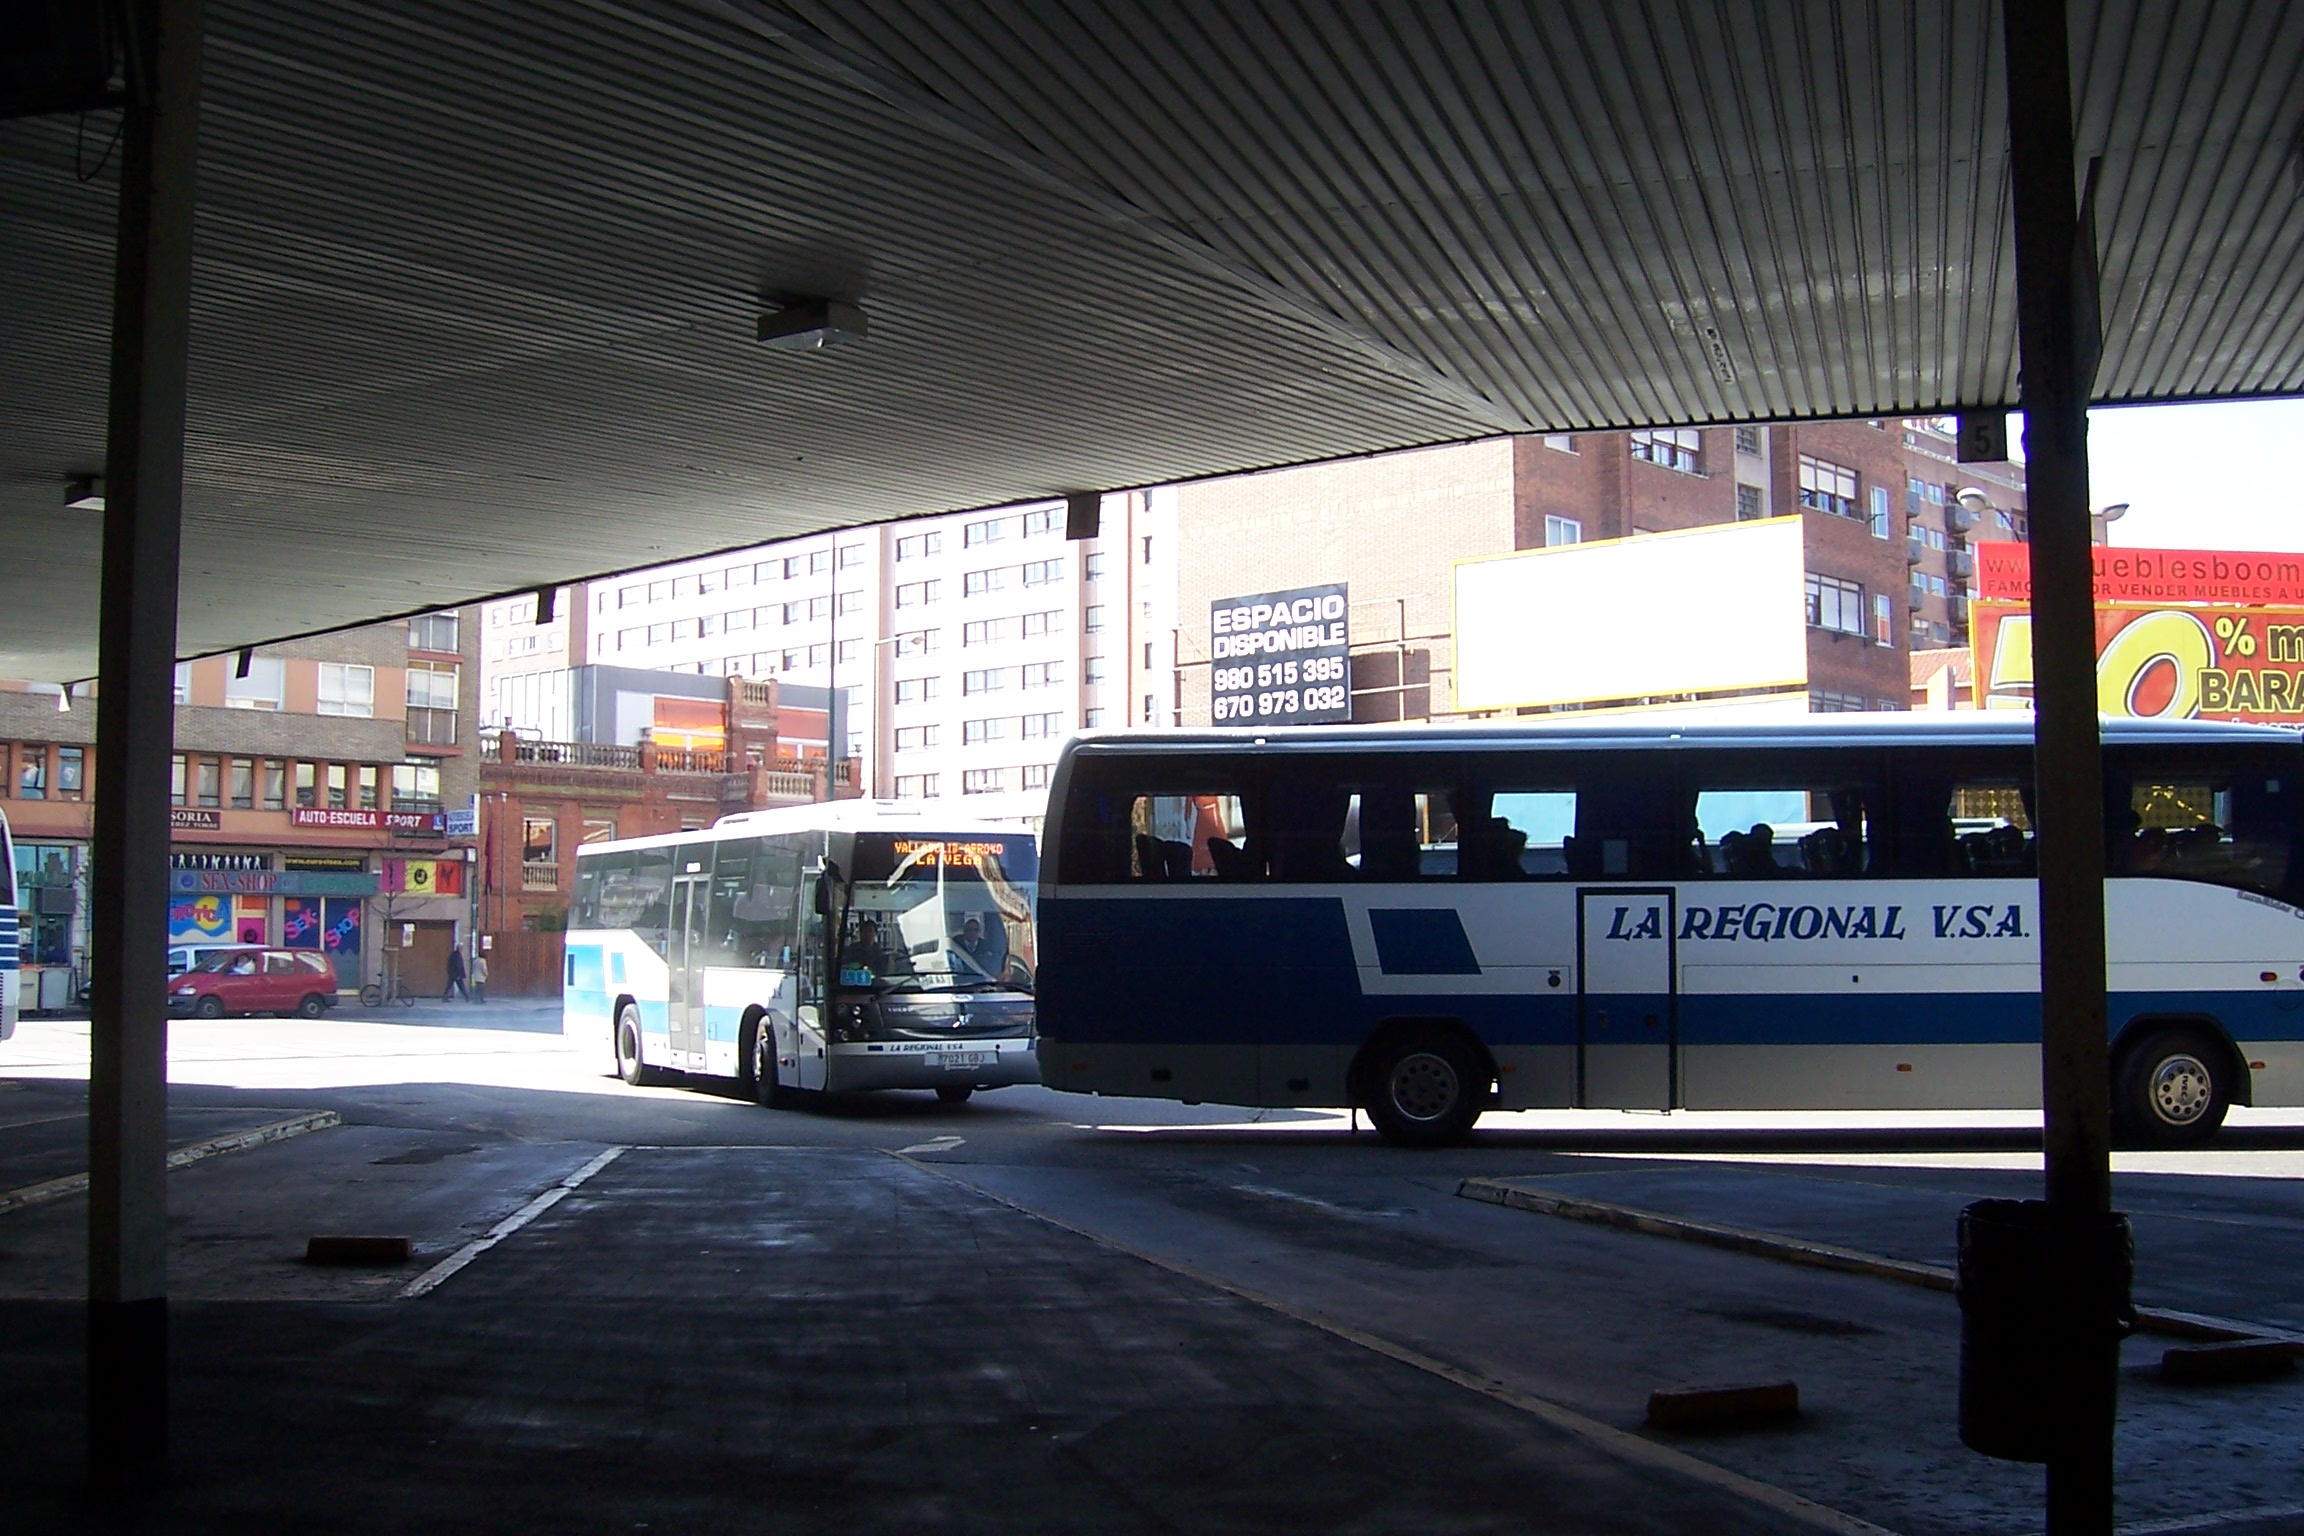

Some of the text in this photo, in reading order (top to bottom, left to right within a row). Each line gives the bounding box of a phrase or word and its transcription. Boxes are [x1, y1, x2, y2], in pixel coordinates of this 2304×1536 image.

[1976, 425, 1990, 454] 5
[2119, 583, 2187, 597] VENDER
[2195, 585, 2271, 599] MUEBLES
[2278, 587, 2288, 599] A
[1213, 594, 1345, 633] ESPACIO
[1213, 622, 1346, 659] DISPONIBLE
[1214, 656, 1345, 691] 980 515 395
[1214, 685, 1346, 719] 670 973 032
[299, 810, 422, 828] AUTO-ESCUELA SPORT
[449, 823, 474, 833] SPORT
[915, 853, 983, 866] LA VEGA
[202, 873, 277, 891] SEX-SHOP
[325, 906, 361, 948] SHOP
[1605, 903, 2031, 942] LA REGIONAL V.S.A.
[943, 1053, 965, 1064] 7021
